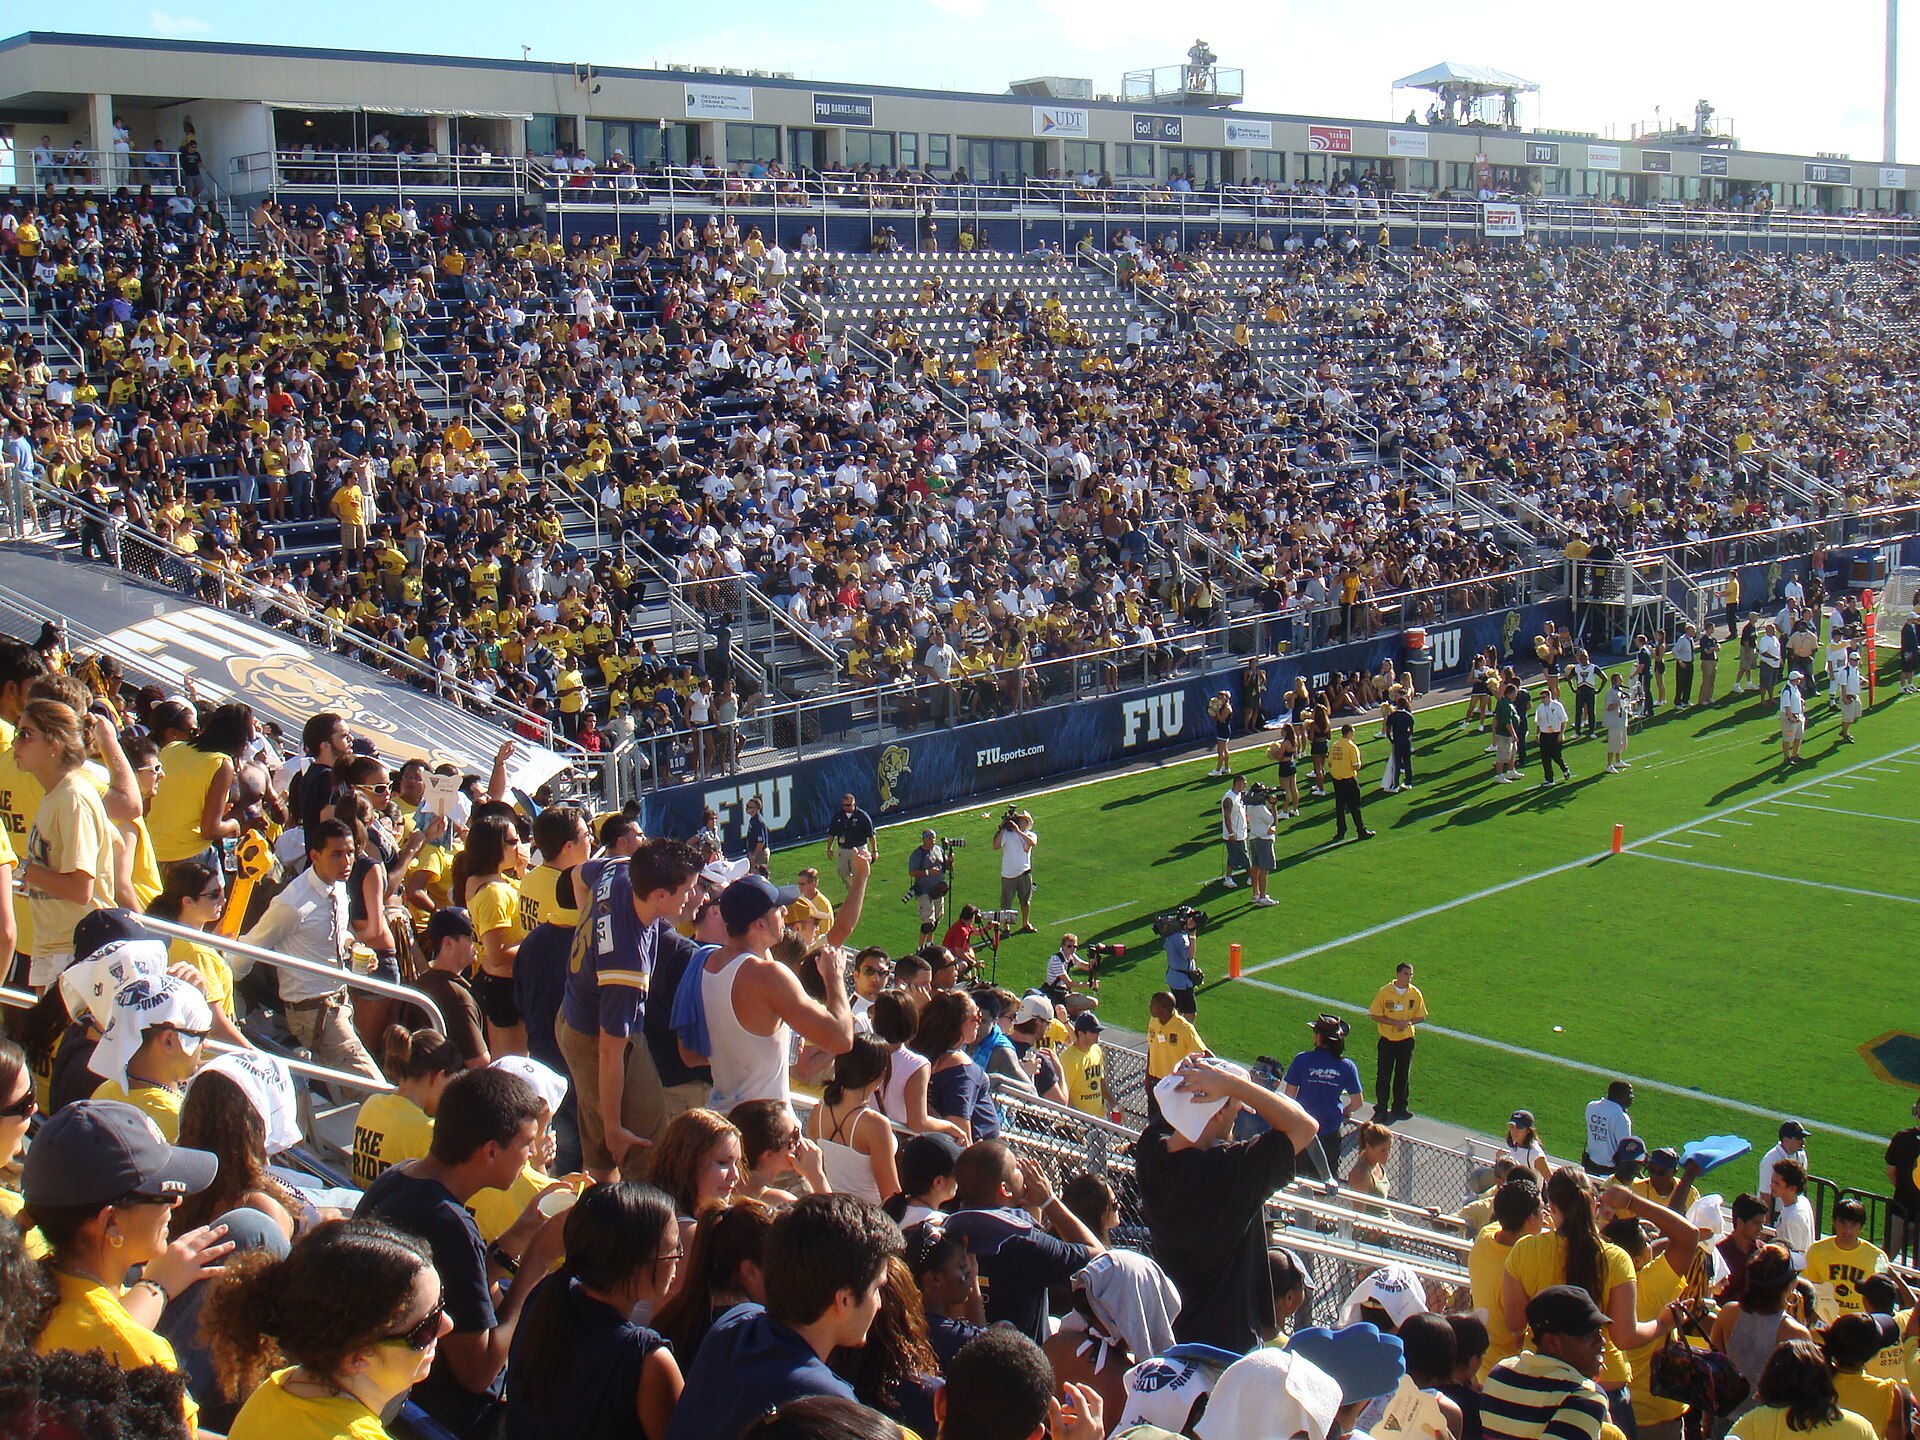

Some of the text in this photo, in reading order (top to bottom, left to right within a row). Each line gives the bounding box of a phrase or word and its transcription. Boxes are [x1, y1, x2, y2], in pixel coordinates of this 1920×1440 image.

[815, 102, 830, 115] FIU
[1055, 111, 1083, 126] UDT
[1135, 121, 1180, 136] Go! Go!
[1535, 146, 1551, 160] FIU
[1812, 165, 1827, 181] FIU
[1486, 215, 1516, 225] ESPN
[1122, 690, 1185, 748] FIU
[669, 756, 686, 769] 110
[704, 775, 793, 846] FIU
[520, 894, 540, 918] THE
[1084, 1064, 1101, 1081] FIU
[353, 1125, 384, 1158] THE
[161, 1180, 187, 1193] FIU
[1828, 1263, 1866, 1285] FIU
[1879, 1348, 1904, 1359] EVEN
[1879, 1358, 1901, 1367] STA
